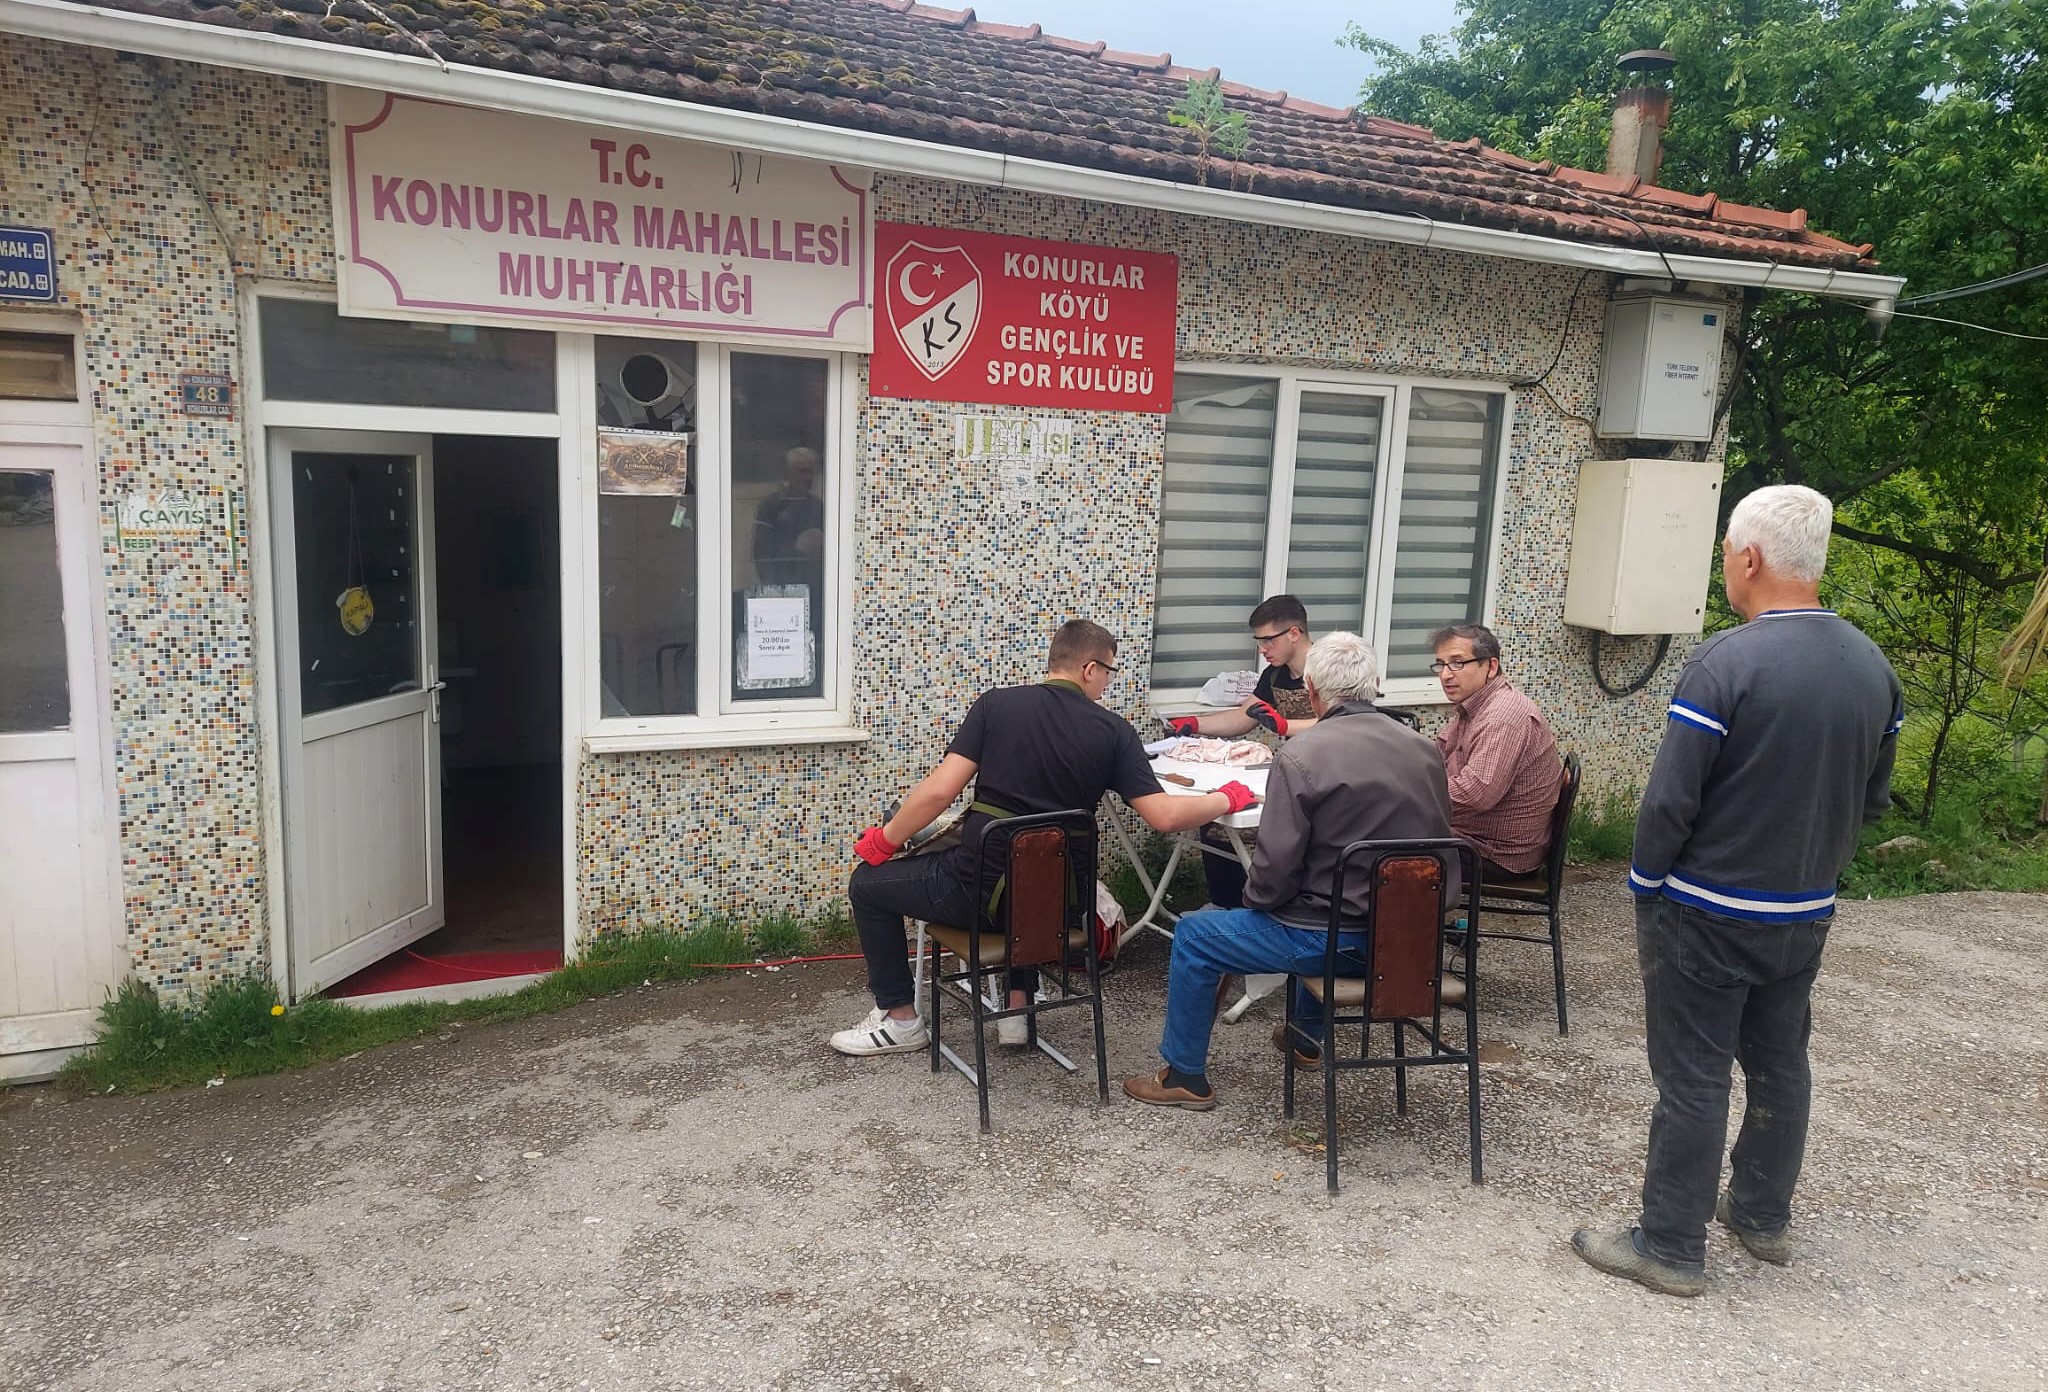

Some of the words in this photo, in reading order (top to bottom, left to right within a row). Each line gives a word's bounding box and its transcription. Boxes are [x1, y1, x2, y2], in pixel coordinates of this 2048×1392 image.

[590, 138, 664, 189] T.C.
[372, 174, 620, 246] KONURLAR
[633, 205, 850, 266] MAHALLESİ
[0, 240, 32, 258] MAH.
[0, 270, 35, 289] CAD.
[498, 252, 752, 315] MUHTARLIĞI
[1003, 251, 1145, 290] KONURLAR
[1040, 290, 1109, 322] KÖYÜ
[1000, 325, 1107, 360] GENÇLİK
[1115, 335, 1144, 360] VE
[195, 386, 218, 402] 48
[986, 360, 1051, 388] SPOR
[1059, 363, 1154, 395] KULÜBÜ
